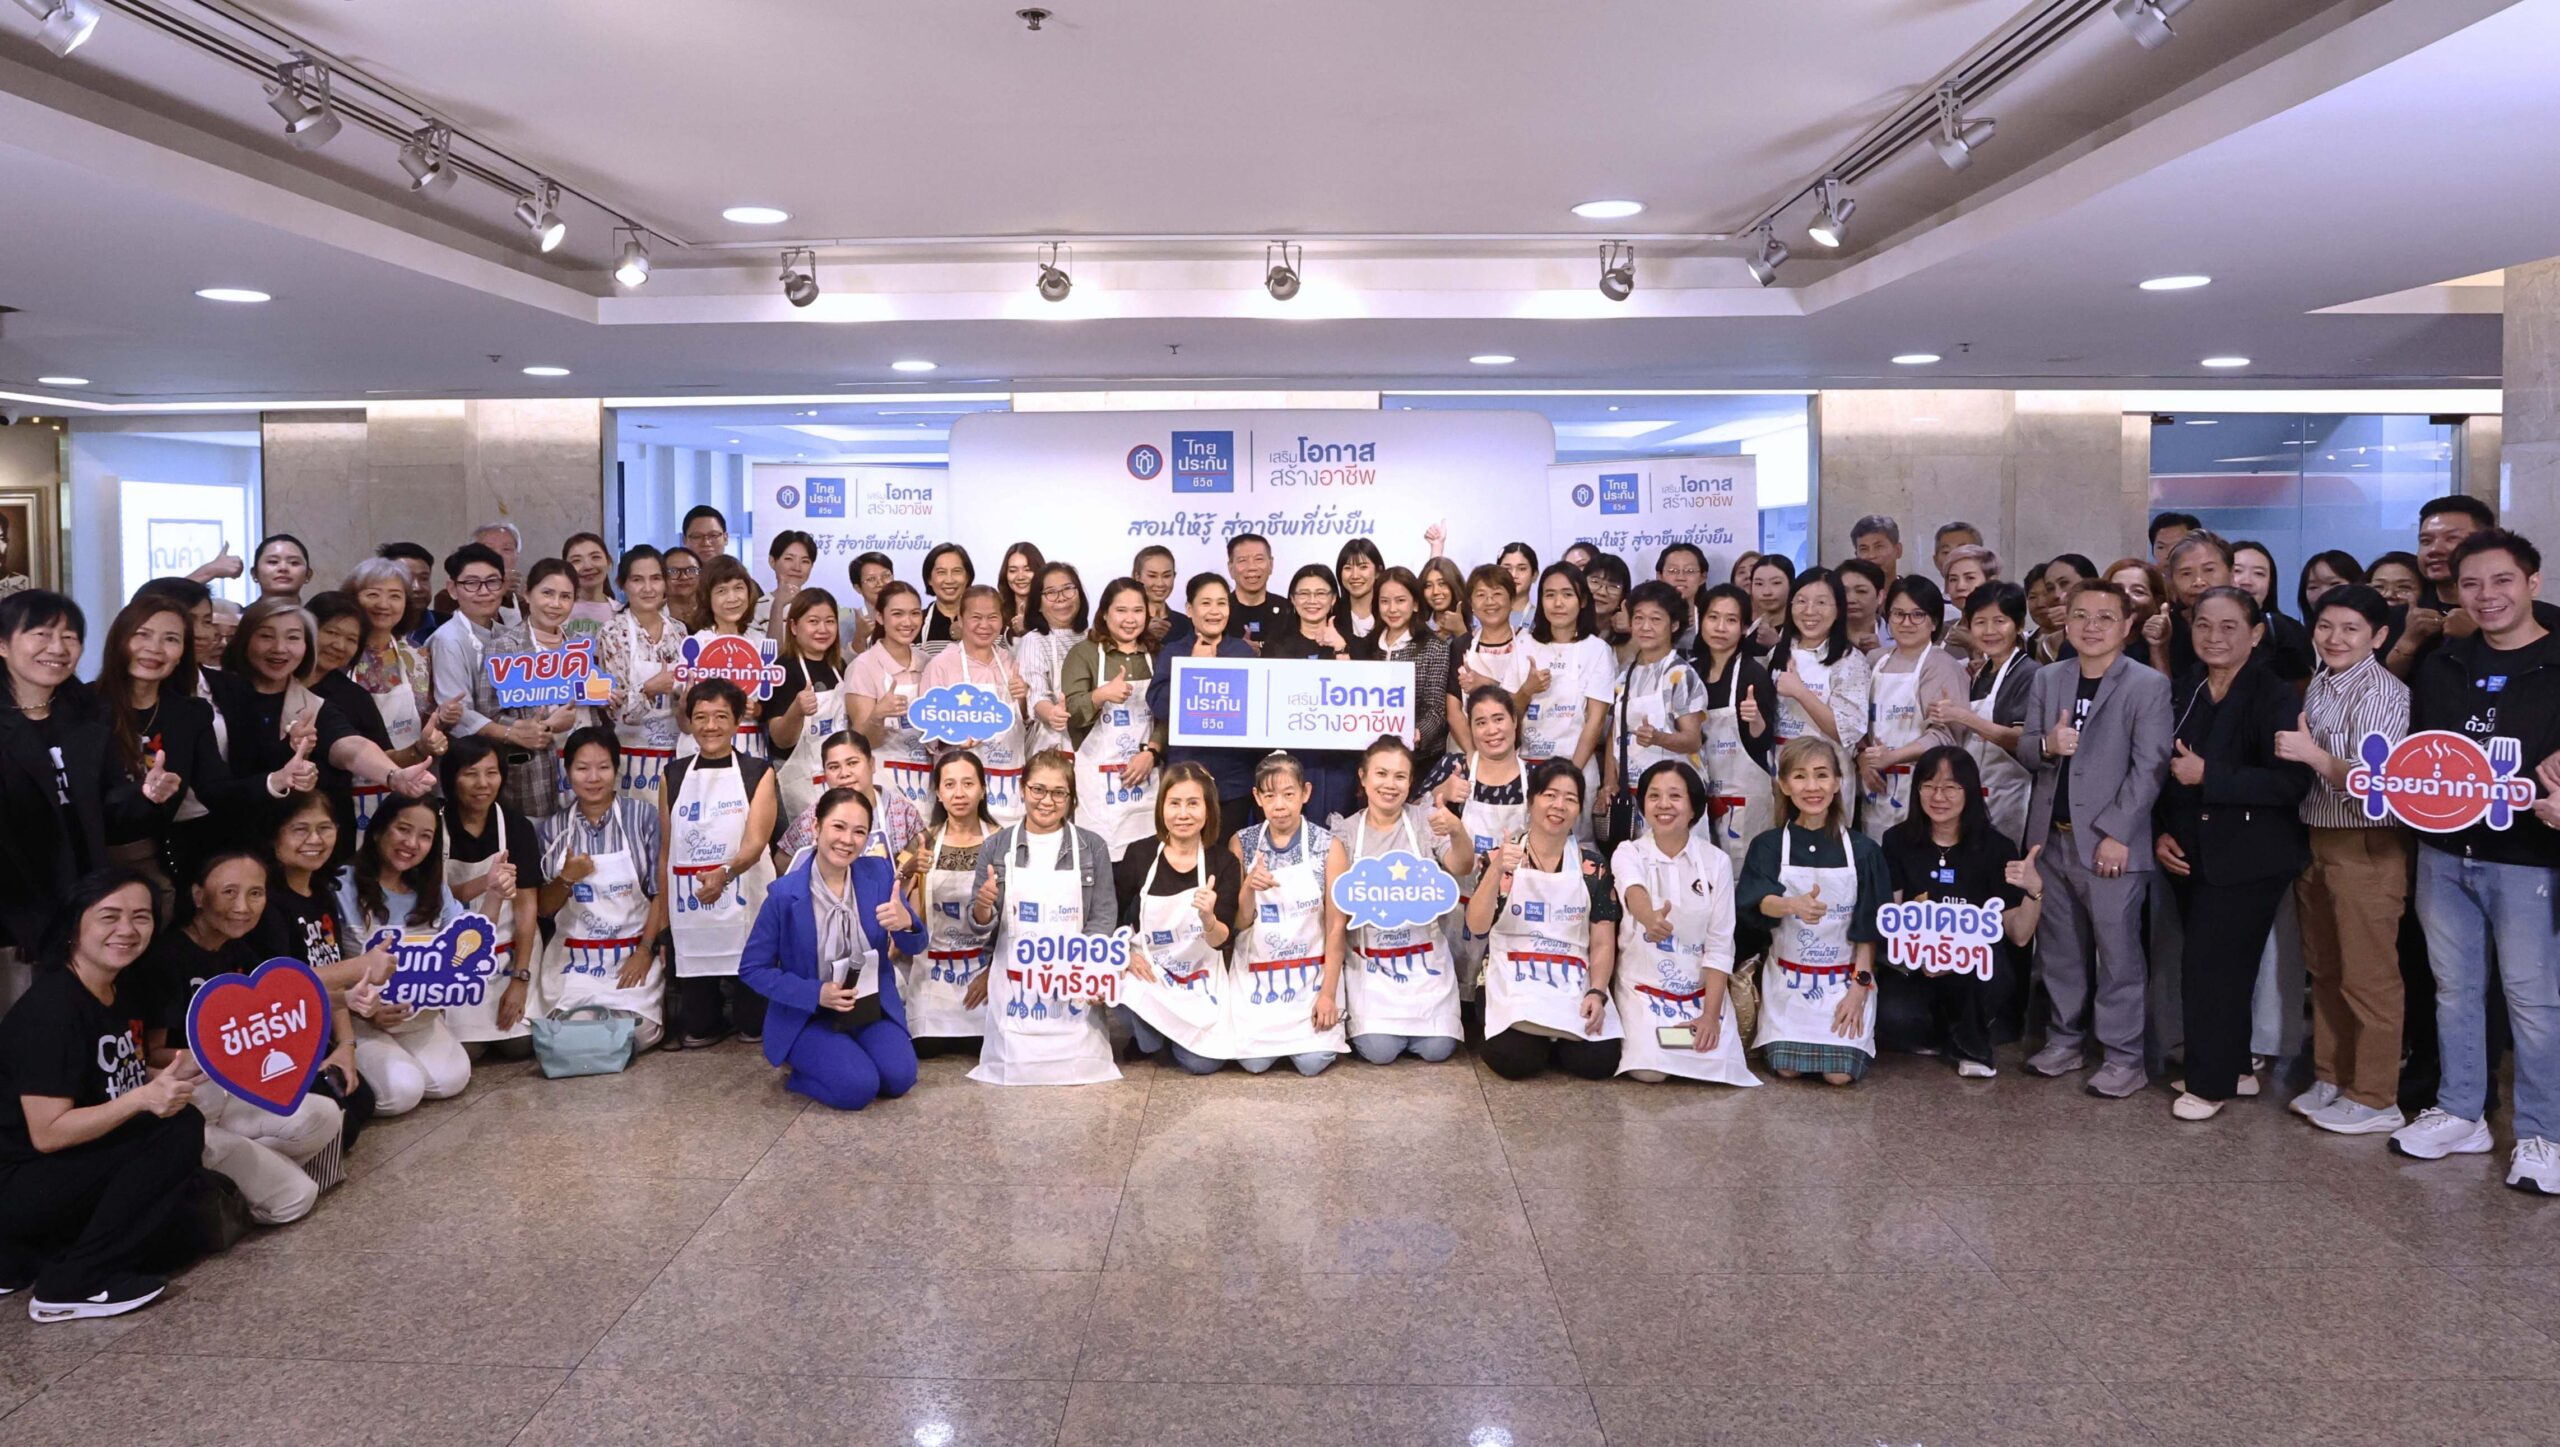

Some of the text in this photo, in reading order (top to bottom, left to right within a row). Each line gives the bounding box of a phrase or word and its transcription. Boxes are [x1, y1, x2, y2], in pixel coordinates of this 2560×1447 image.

[1182, 438, 1217, 455] ไทย
[1178, 454, 1228, 471] ประกัน
[1192, 475, 1214, 488] ชีวิต
[1270, 464, 1376, 487] สร้างอาชีพ
[1605, 479, 1628, 490] ไทย
[809, 493, 841, 505] ประกัน
[812, 482, 835, 494] ไทย
[1603, 489, 1635, 501] ประกัน
[1127, 511, 1217, 545] สอนให้รู้
[489, 639, 591, 683] ขายดี
[501, 680, 571, 704] ของแทร่
[1192, 675, 1230, 695] ไทย
[920, 696, 1003, 724] เริ่ดเลยล่ะ
[1186, 694, 1241, 712] ประกัน
[1201, 717, 1224, 730] ชีวิต
[1287, 707, 1406, 733] สร้างอาชีพ
[2353, 762, 2530, 802] อร่อยฉ่ำทำถึง
[1347, 870, 1446, 902] เริ่ดเลยล่ะ
[1881, 901, 2000, 938] ออเดอร์
[1016, 930, 1128, 966] ออเดอร์
[1892, 933, 1988, 976] เข้ารัวๆ
[1026, 964, 1116, 1002] เข้ารัวๆ
